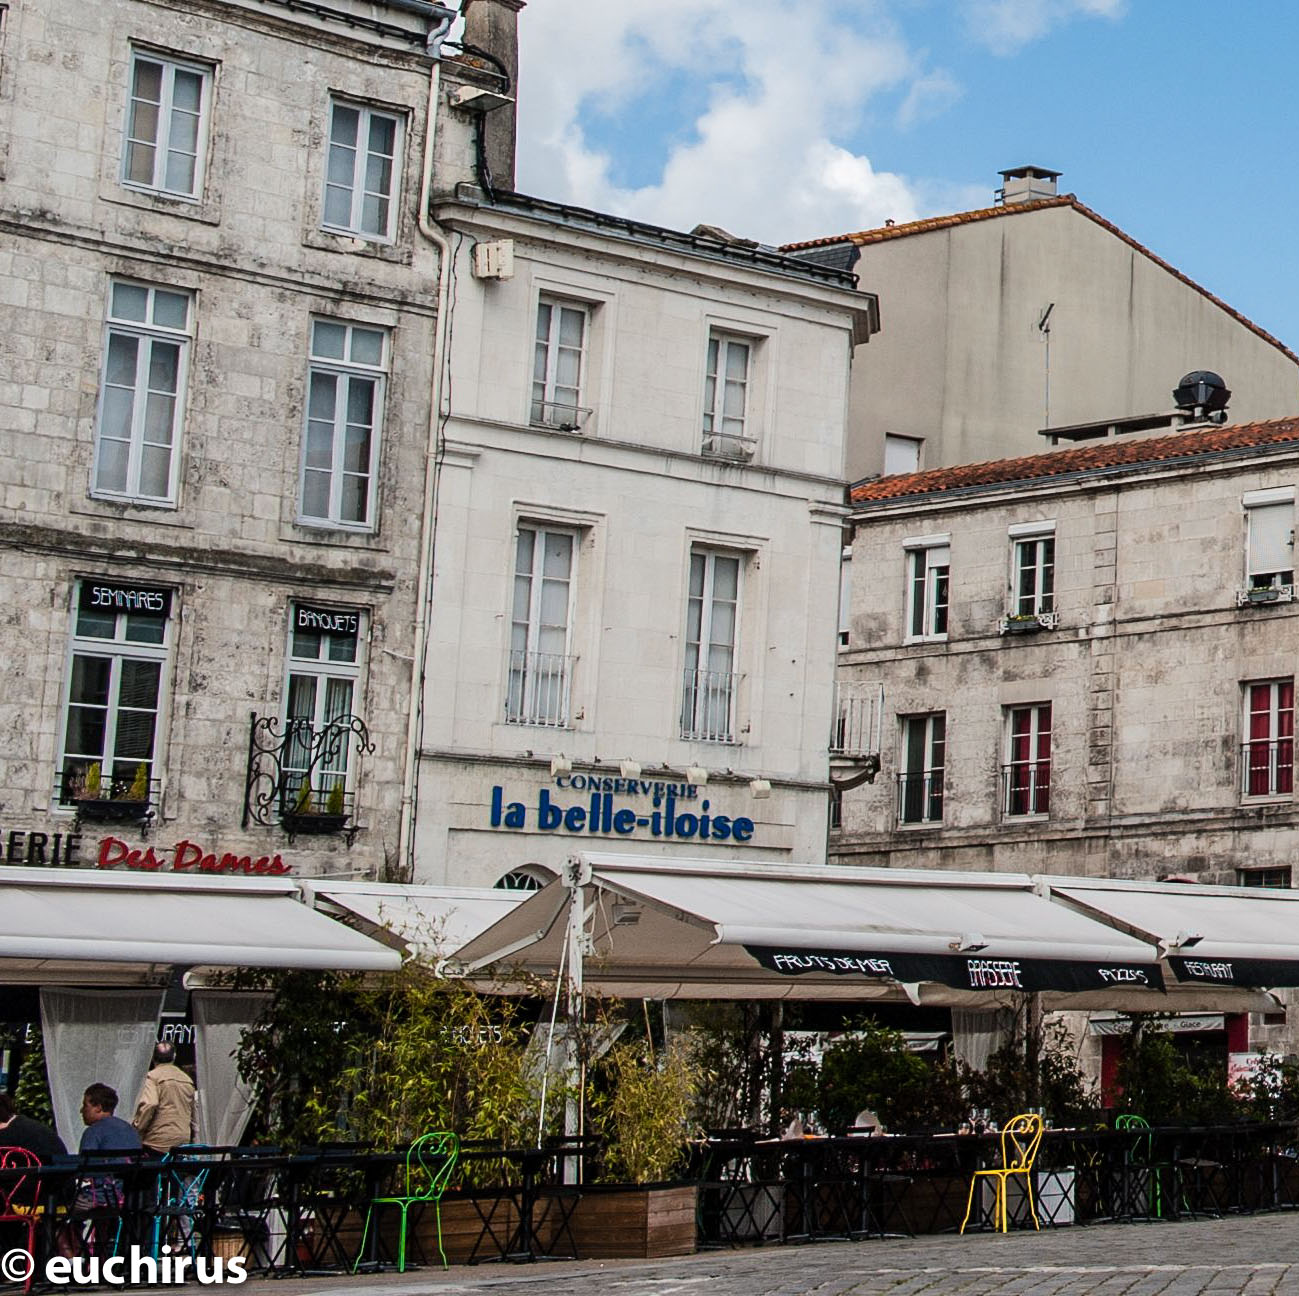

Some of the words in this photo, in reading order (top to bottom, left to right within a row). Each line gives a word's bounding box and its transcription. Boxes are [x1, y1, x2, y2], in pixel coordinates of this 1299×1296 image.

[91, 587, 164, 610] SEMINAIRES
[298, 609, 357, 633] BANQUETS
[556, 775, 698, 799] CONSERVERIE
[490, 785, 526, 828] la
[538, 788, 755, 842] belle-iloise
[0, 830, 83, 865] ERIE
[96, 836, 166, 869] Des
[170, 840, 292, 874] Dames
